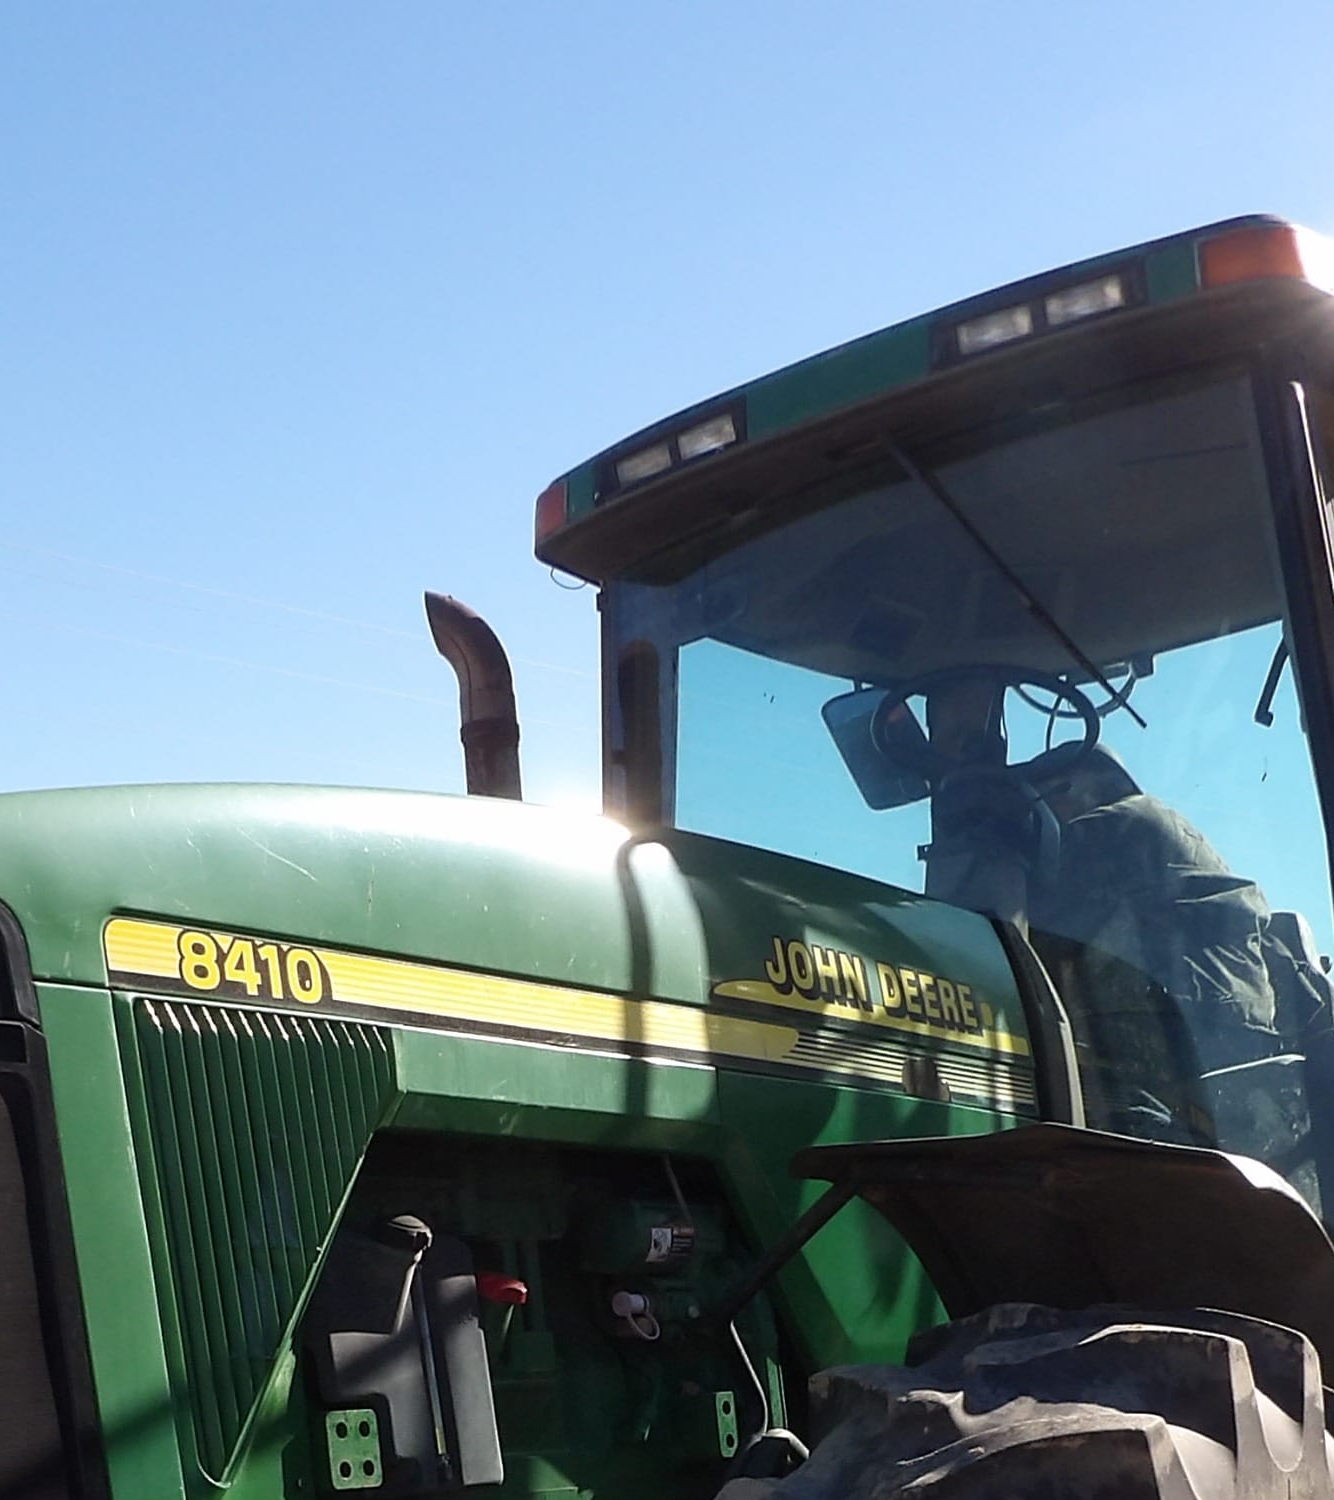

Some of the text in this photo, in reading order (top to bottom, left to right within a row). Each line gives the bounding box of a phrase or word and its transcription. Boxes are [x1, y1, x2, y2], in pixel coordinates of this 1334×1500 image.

[178, 930, 323, 1004] 8410
[765, 936, 982, 1034] JOHN DEERE
